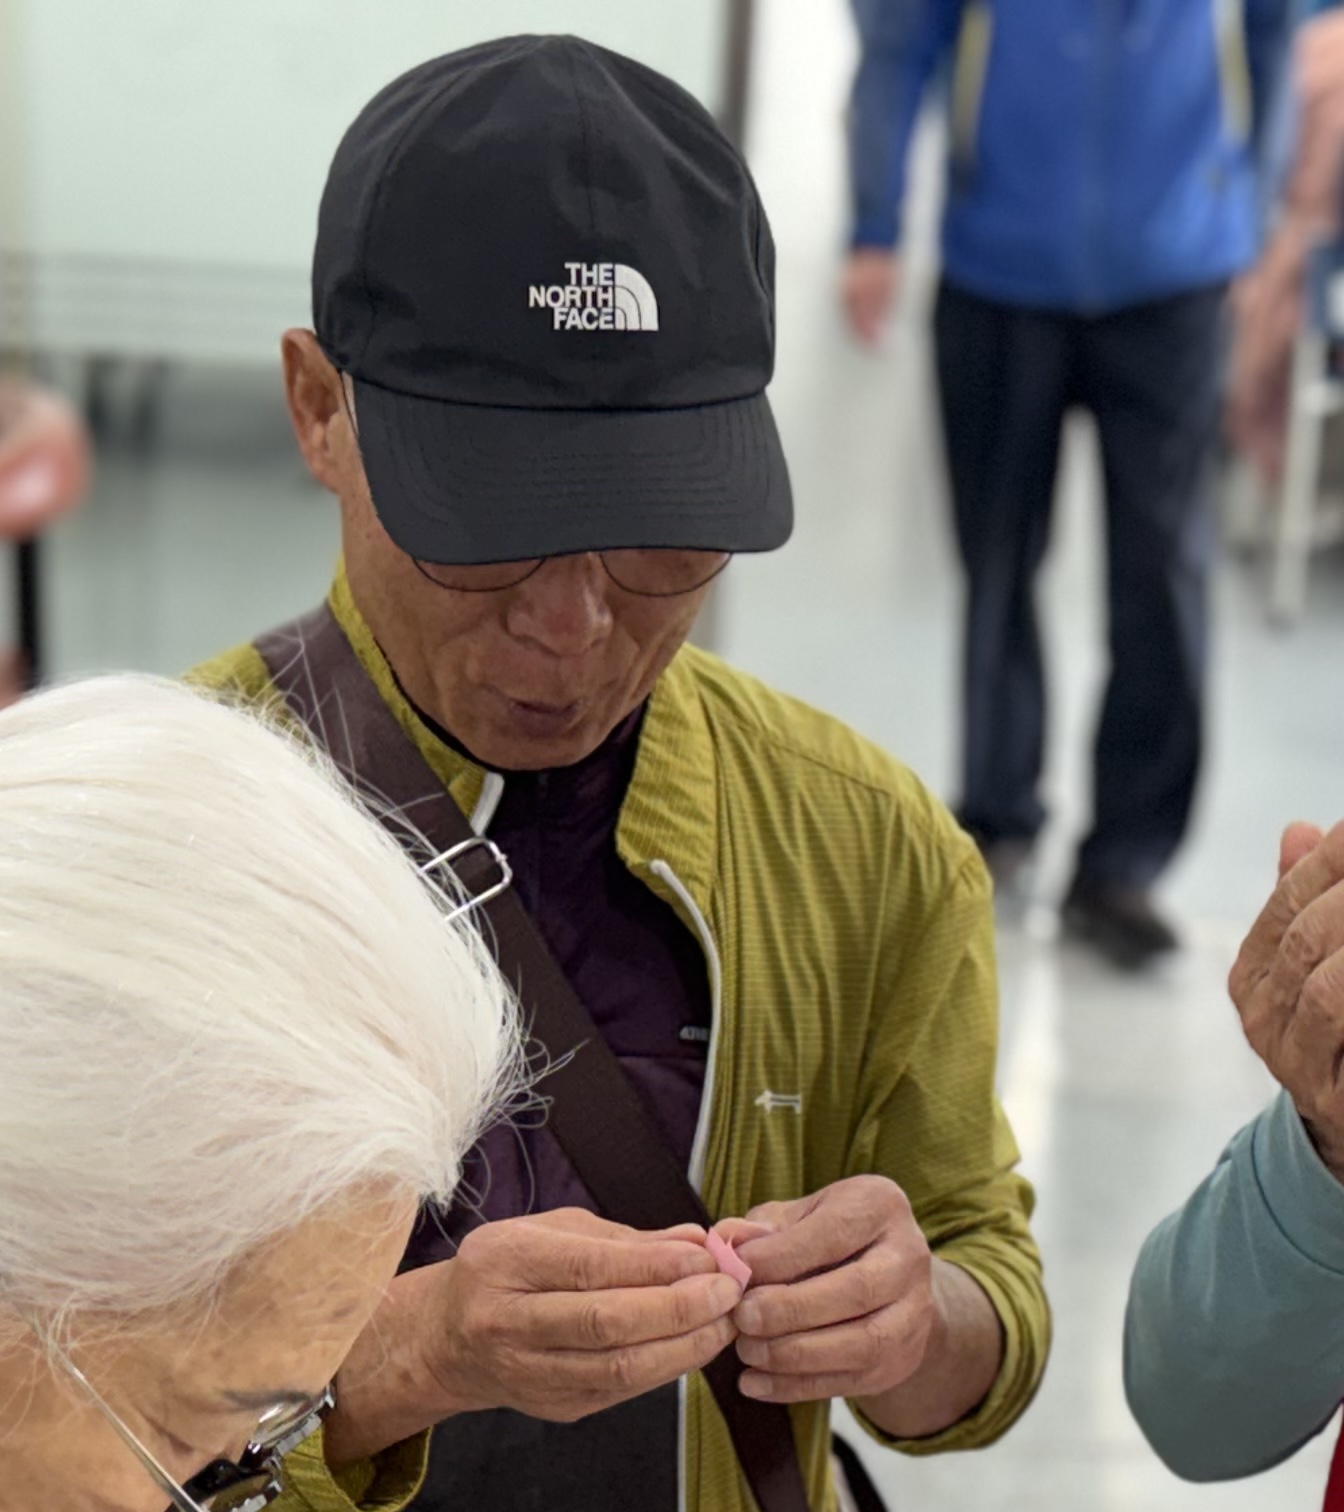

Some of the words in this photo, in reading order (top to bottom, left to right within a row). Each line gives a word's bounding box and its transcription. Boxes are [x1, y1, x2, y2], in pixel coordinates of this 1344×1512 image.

[564, 262, 614, 286] THE
[528, 285, 614, 309] NORTH
[553, 307, 614, 331] FACE
